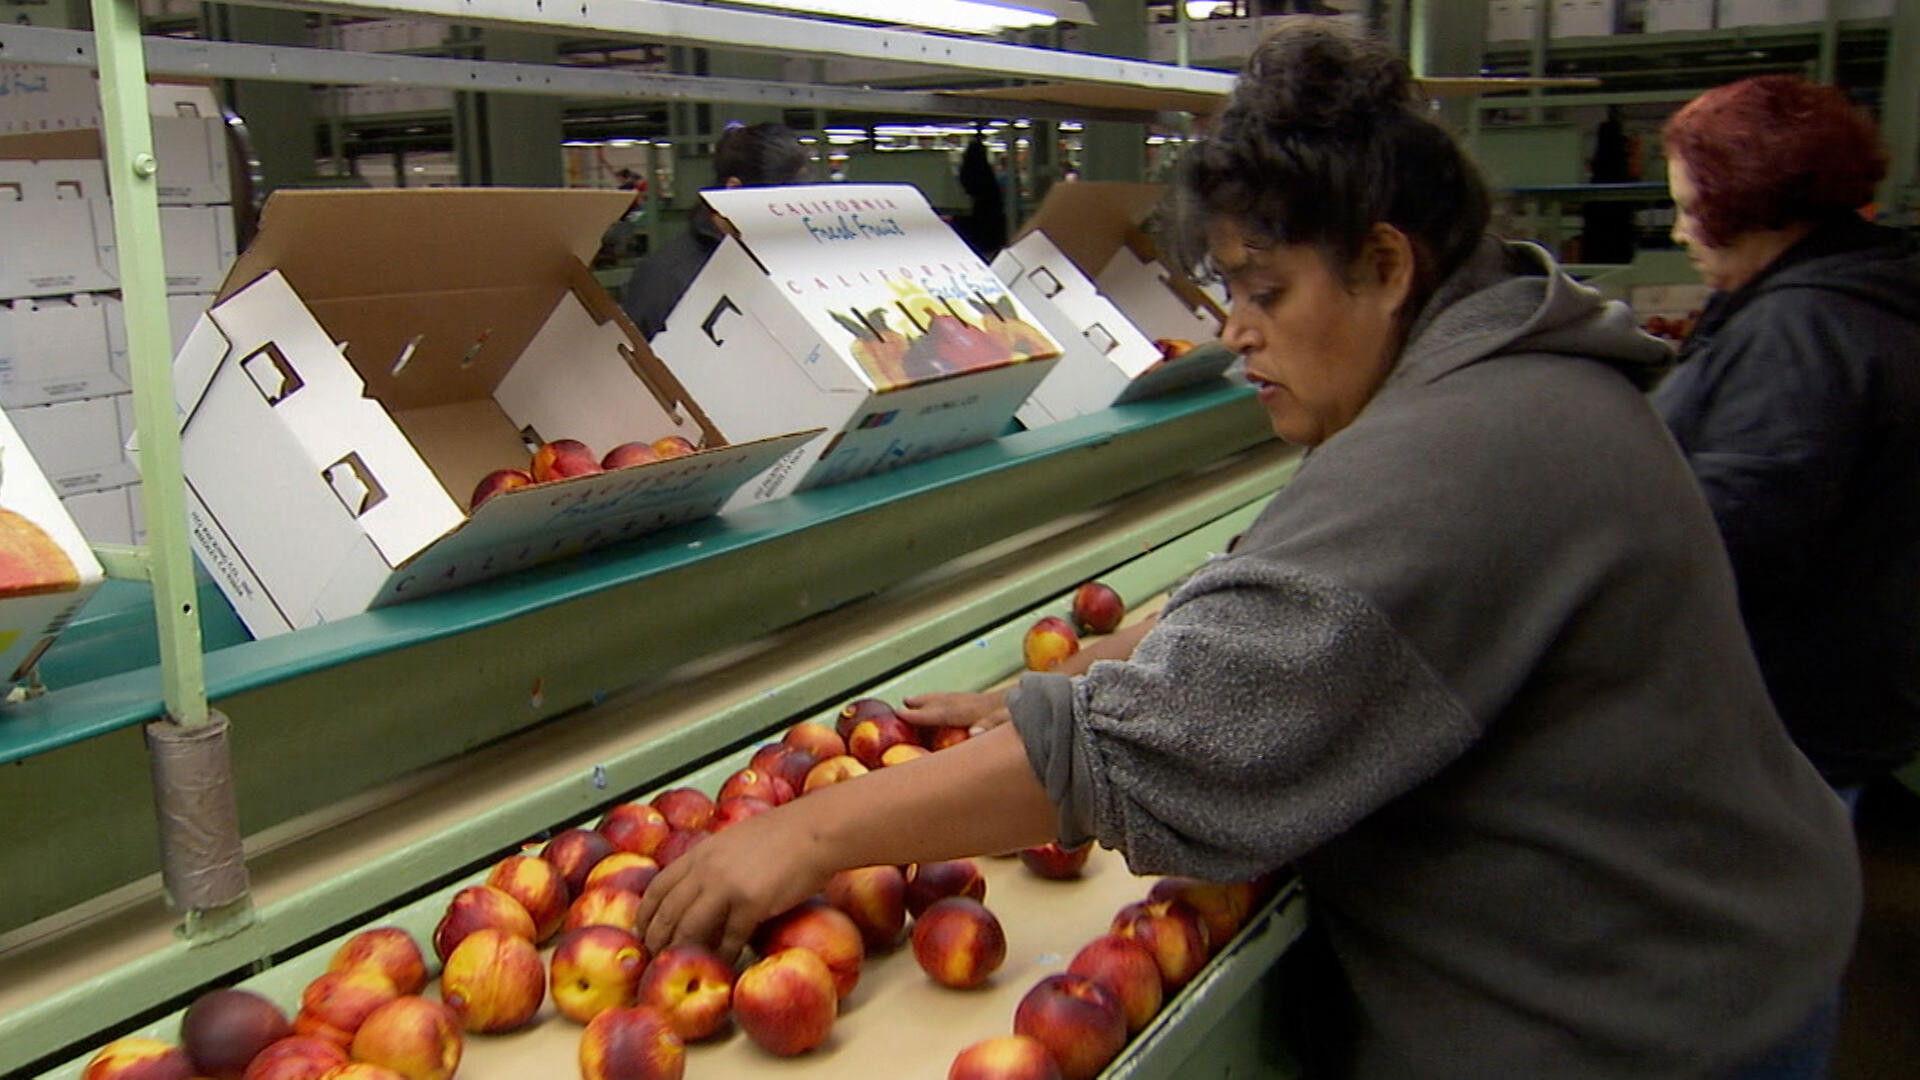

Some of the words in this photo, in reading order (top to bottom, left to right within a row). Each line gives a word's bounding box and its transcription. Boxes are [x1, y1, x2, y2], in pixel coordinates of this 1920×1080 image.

[768, 199, 898, 217] CALIFORNIA
[851, 213, 906, 240] Fruit
[787, 262, 986, 294] CALIFORNIA
